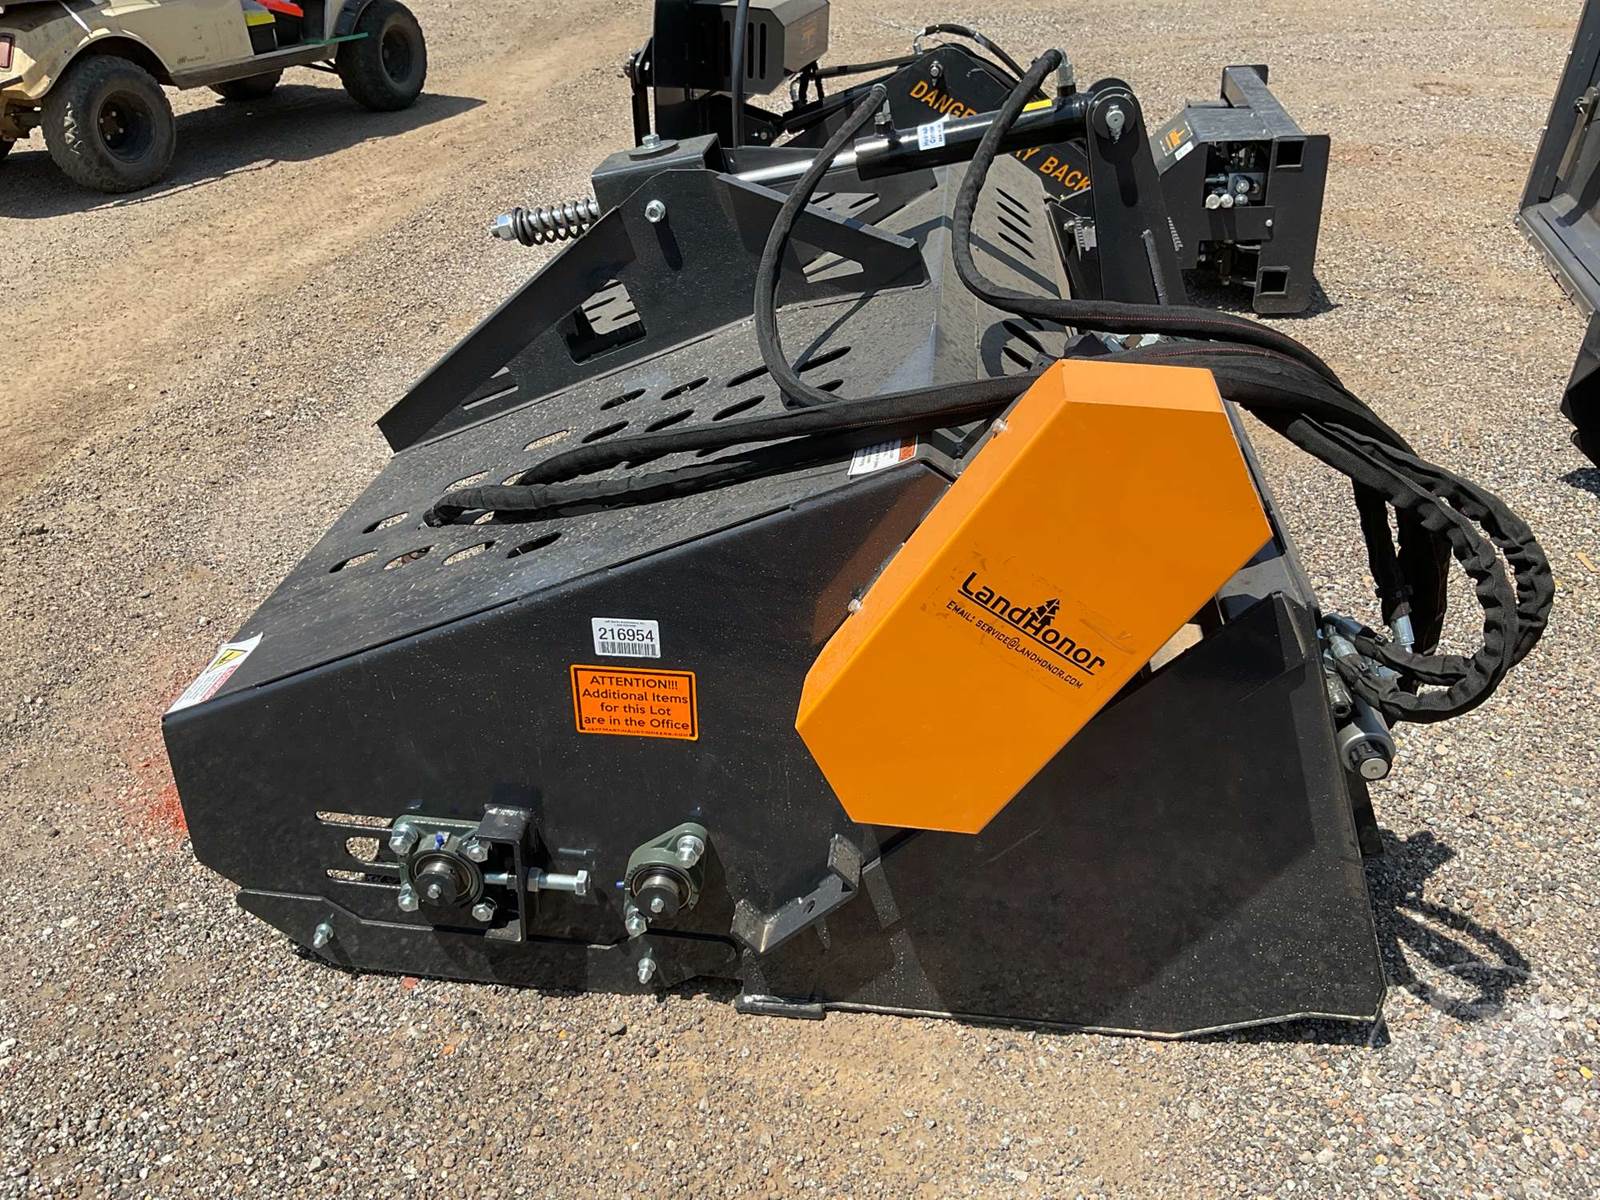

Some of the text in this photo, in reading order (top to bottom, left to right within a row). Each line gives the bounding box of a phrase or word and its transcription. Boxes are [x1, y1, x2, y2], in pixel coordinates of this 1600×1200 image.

[910, 80, 977, 118] DANGE
[1039, 156, 1091, 191] BACK
[961, 571, 1105, 671] LandHonor
[598, 627, 655, 642] 216954
[946, 600, 1083, 689] EMAIL: SERVICE@LANDHONOR.COM
[590, 675, 678, 690] ATTENTION!!!
[582, 688, 688, 704] Additional Items
[600, 702, 672, 716] for this Lot
[584, 716, 690, 730] are in the Office
